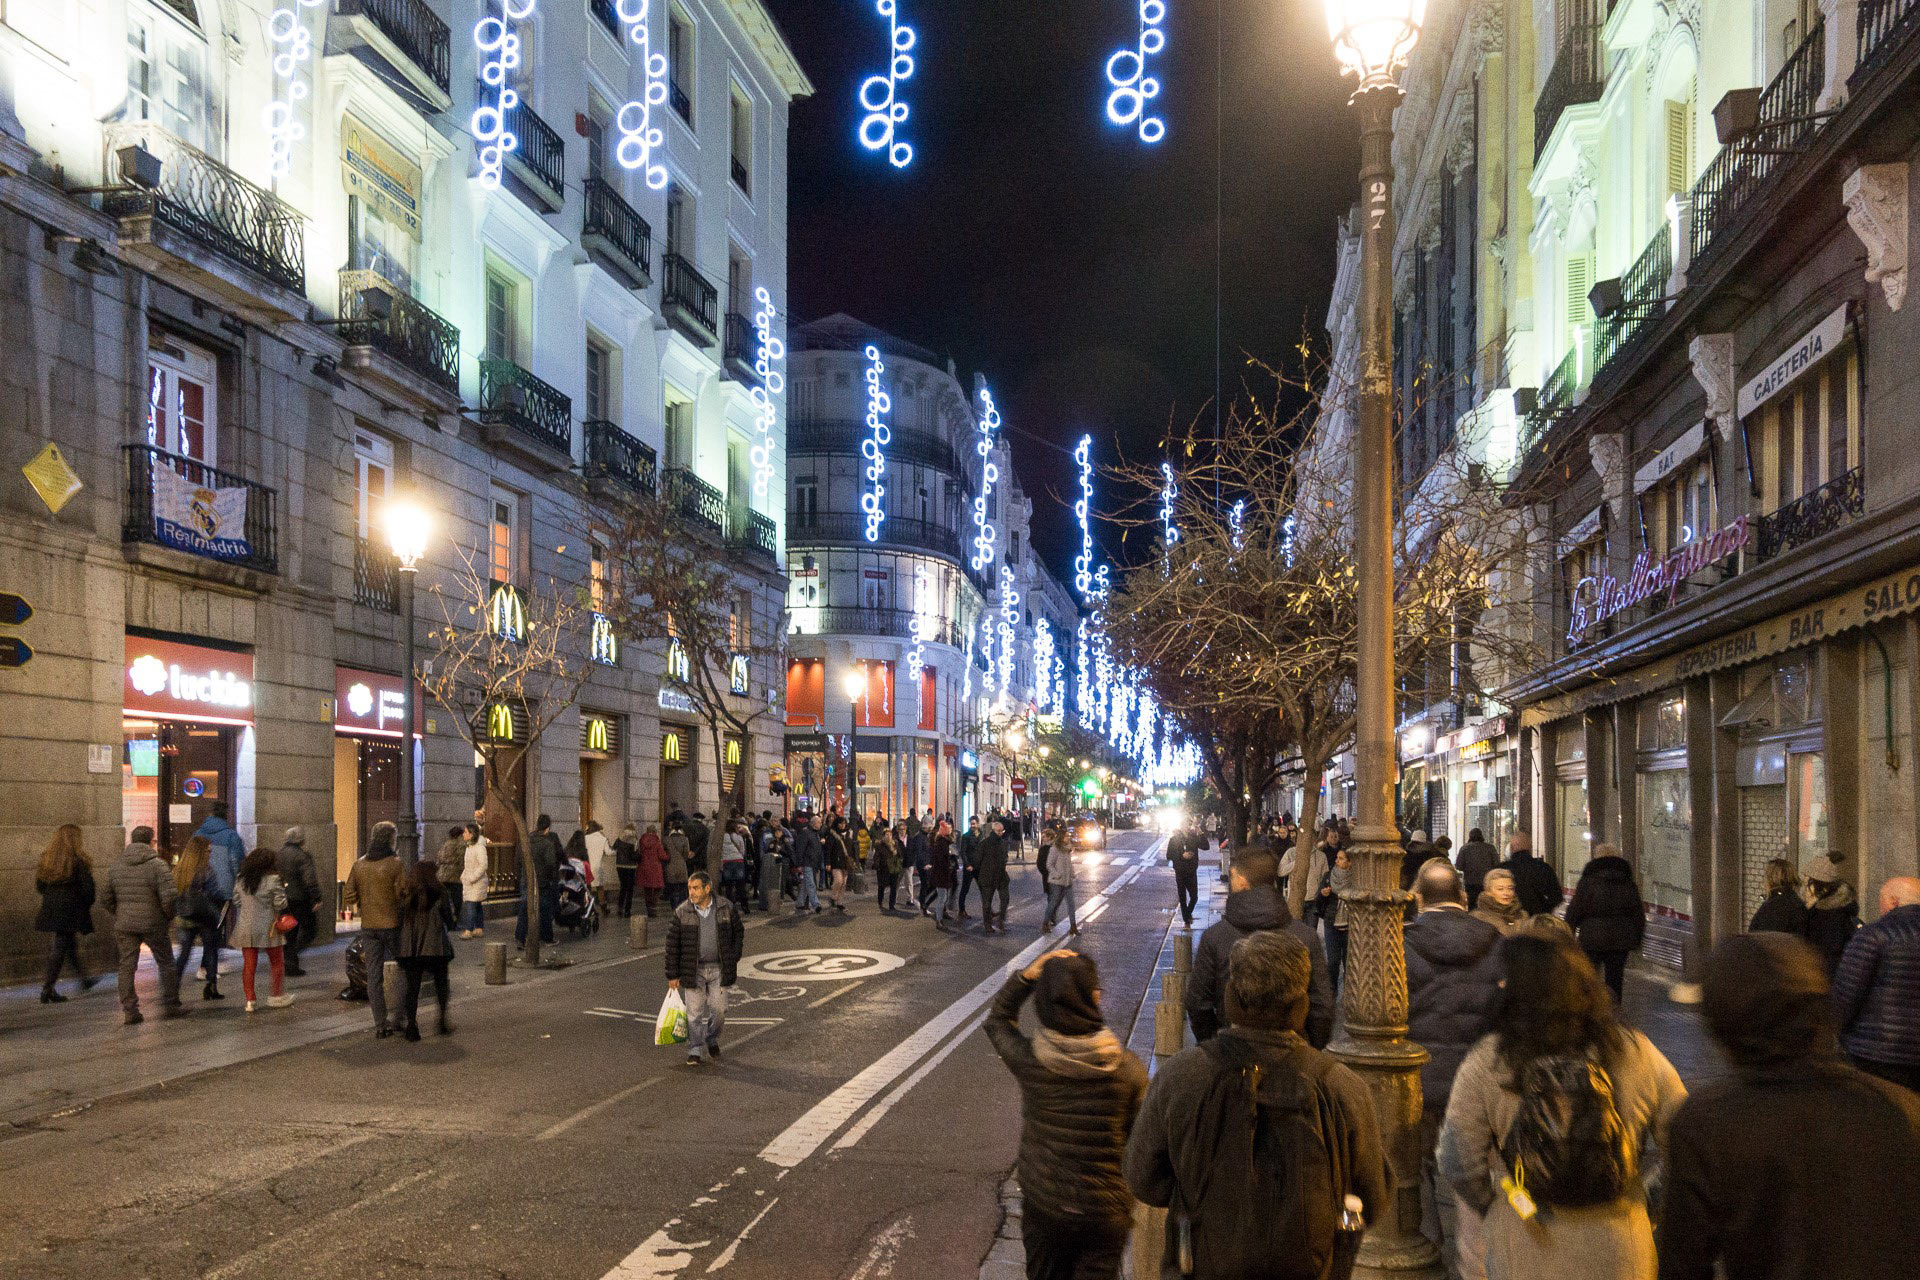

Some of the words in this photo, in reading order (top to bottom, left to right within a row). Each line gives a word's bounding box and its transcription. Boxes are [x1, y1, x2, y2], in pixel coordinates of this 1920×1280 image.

[1753, 335, 1823, 401] CAFETERÍA
[1566, 575, 1599, 643] La
[1596, 514, 1752, 622] Mallorquina
[1788, 607, 1825, 643] BAR
[763, 954, 868, 974] 30
